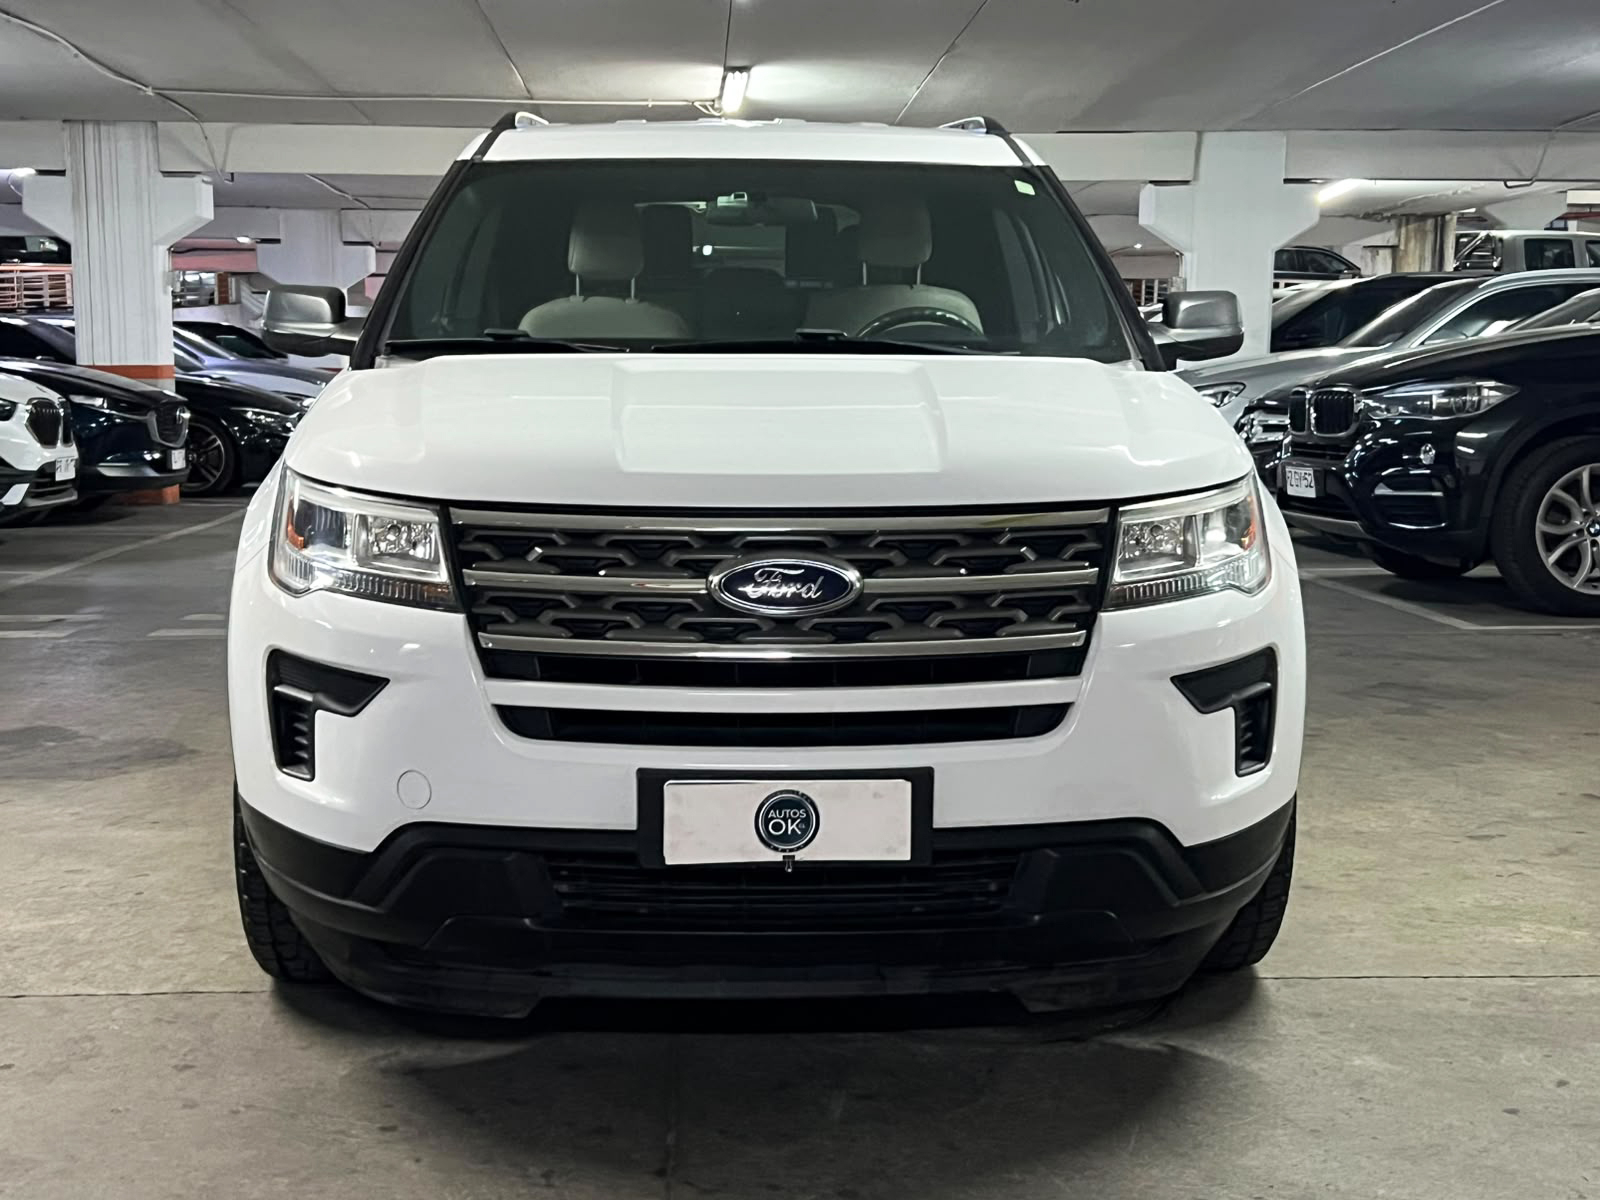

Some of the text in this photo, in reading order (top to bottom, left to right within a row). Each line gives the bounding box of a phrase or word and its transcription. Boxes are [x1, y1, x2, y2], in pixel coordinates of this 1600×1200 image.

[738, 567, 824, 598] Ford
[768, 809, 806, 818] AUTOS
[768, 818, 801, 835] OK
